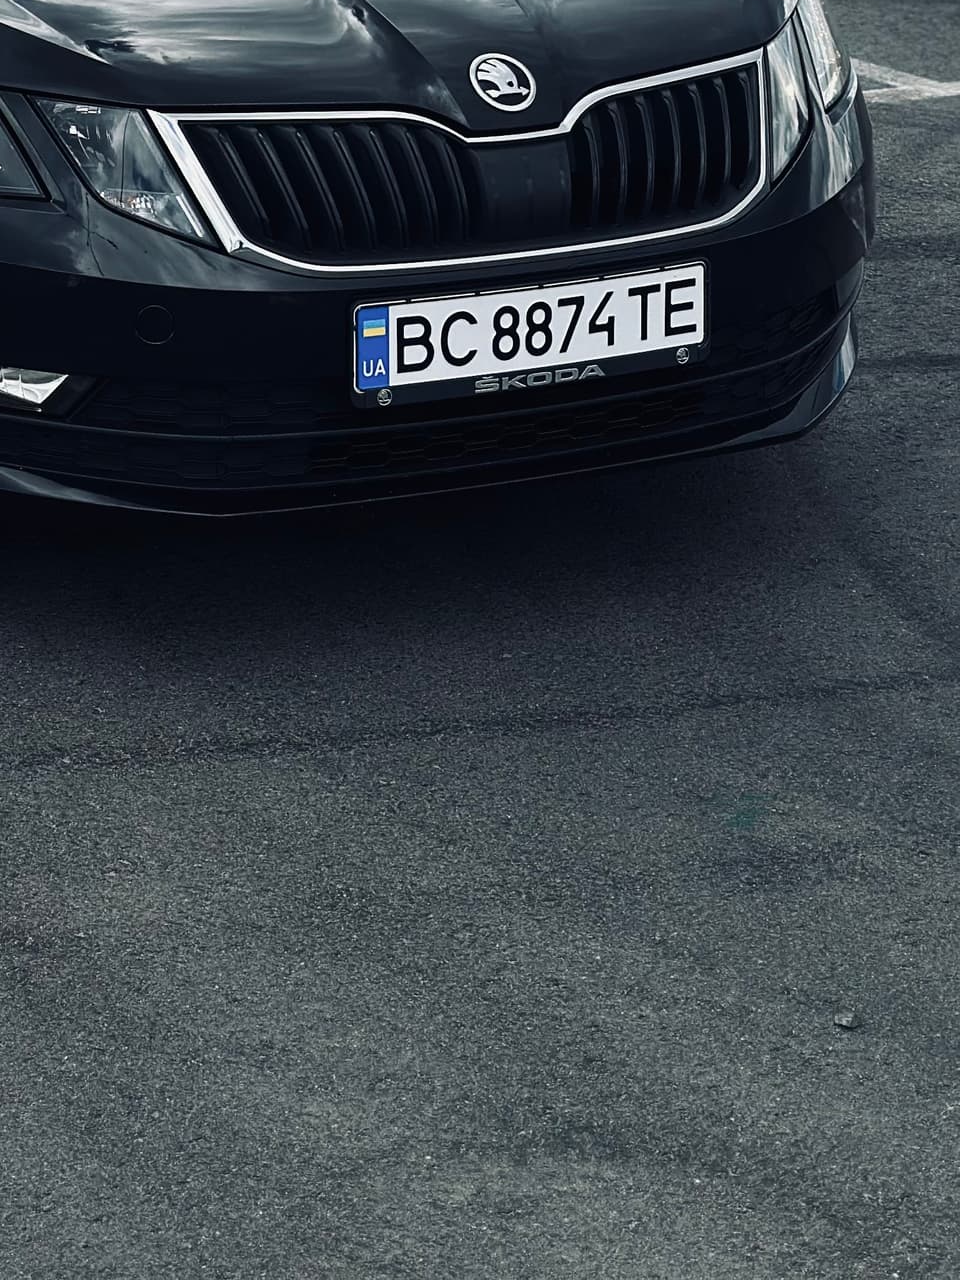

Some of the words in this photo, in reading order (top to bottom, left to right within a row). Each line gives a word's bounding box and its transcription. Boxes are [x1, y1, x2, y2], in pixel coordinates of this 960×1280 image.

[396, 311, 478, 373] BC
[492, 291, 616, 361] 8874
[628, 278, 697, 342] TE
[363, 358, 386, 377] UA
[474, 365, 606, 394] ŠKODA
